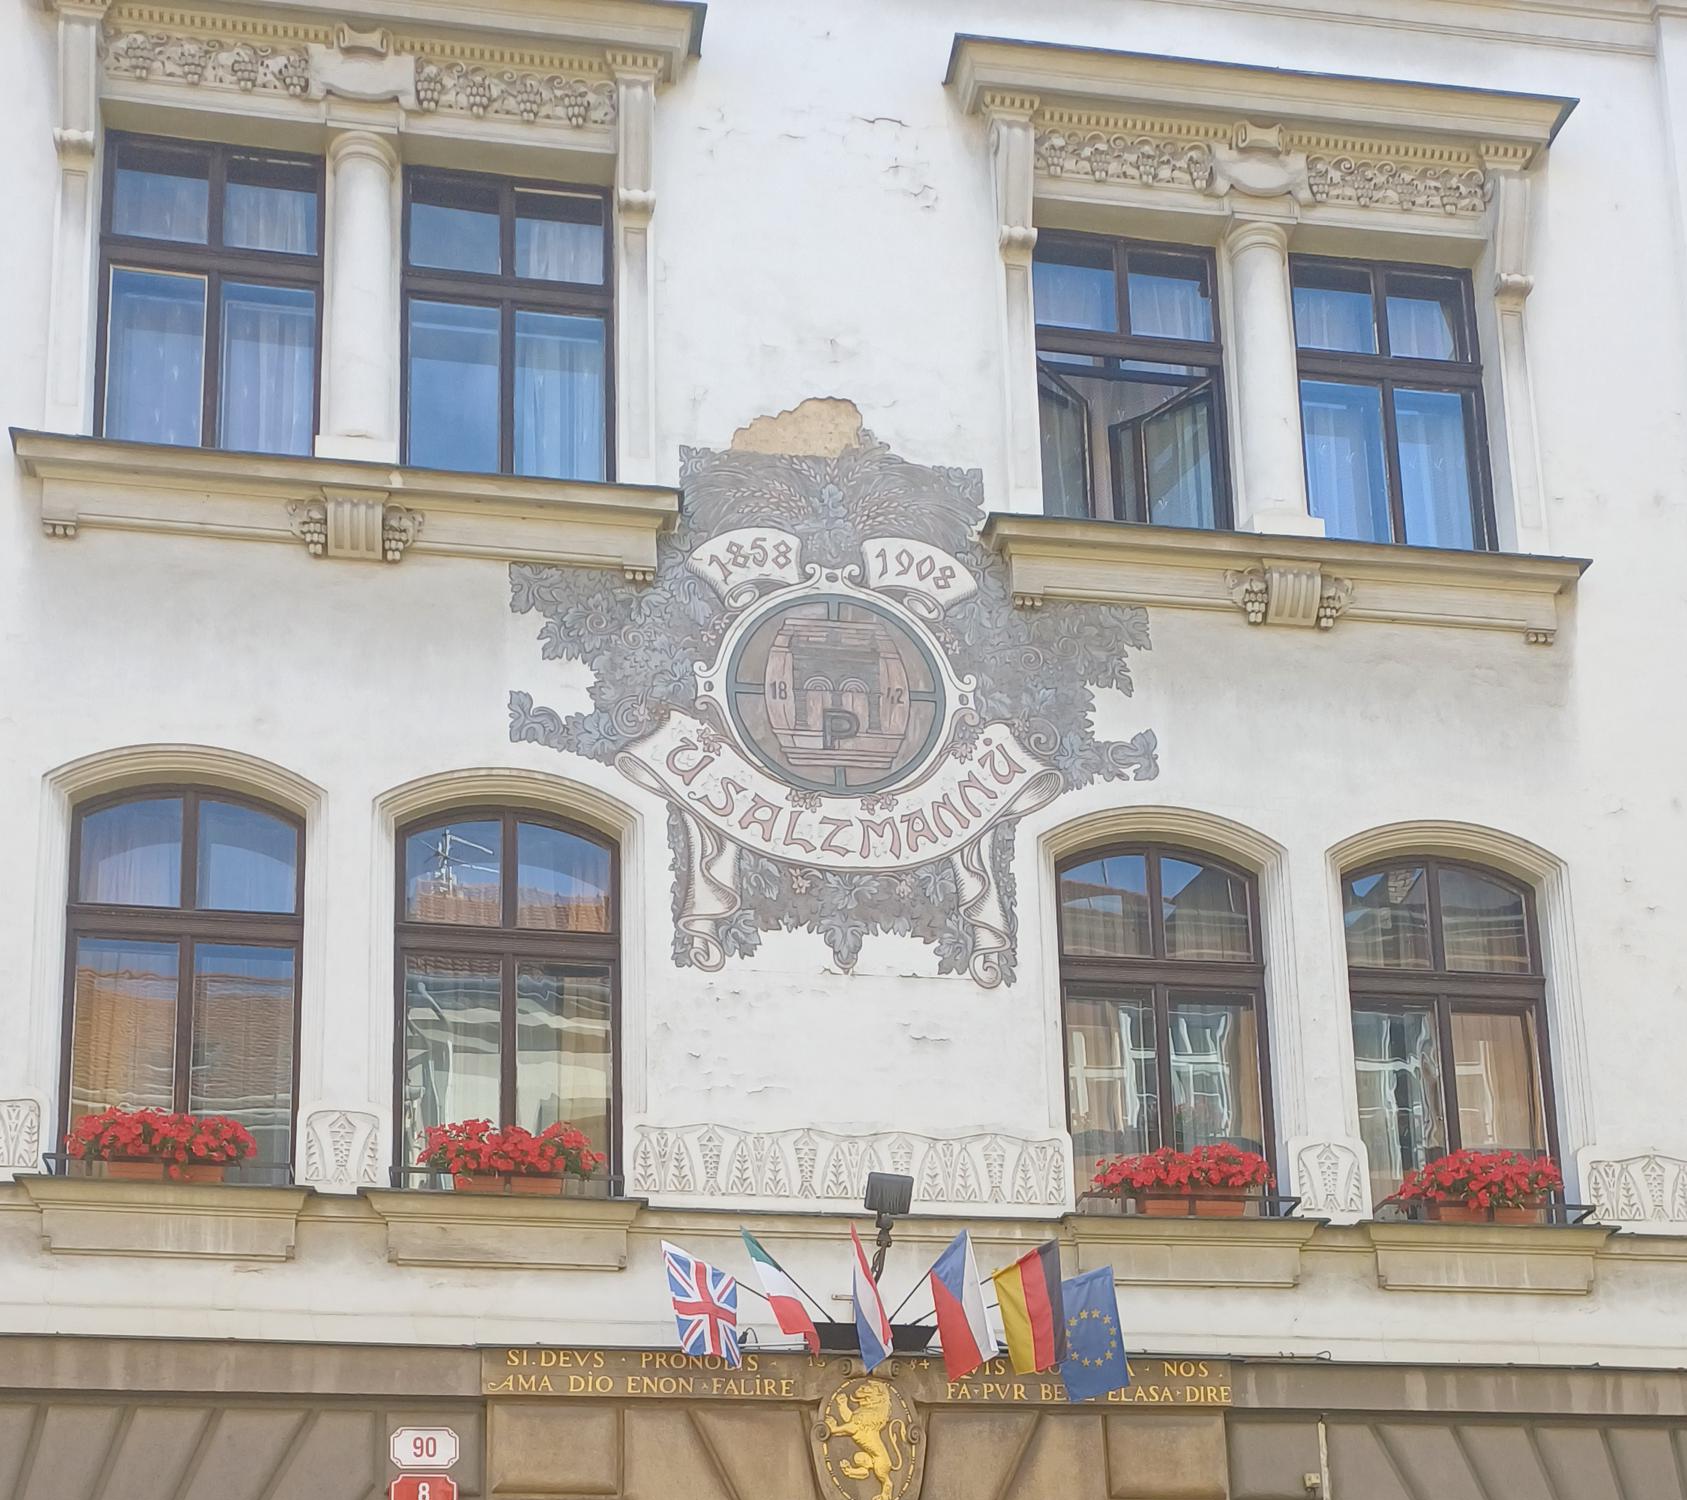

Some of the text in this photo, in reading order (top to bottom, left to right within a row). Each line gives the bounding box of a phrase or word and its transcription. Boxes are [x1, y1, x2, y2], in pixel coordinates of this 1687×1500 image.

[708, 537, 792, 585] 1858
[875, 548, 957, 591] 1908
[769, 681, 787, 700] 18
[823, 708, 860, 749] P
[1164, 1361, 1209, 1378] NOS
[488, 1375, 553, 1392] AMA
[1186, 1386, 1232, 1402] DIRE
[413, 1437, 437, 1457] 90
